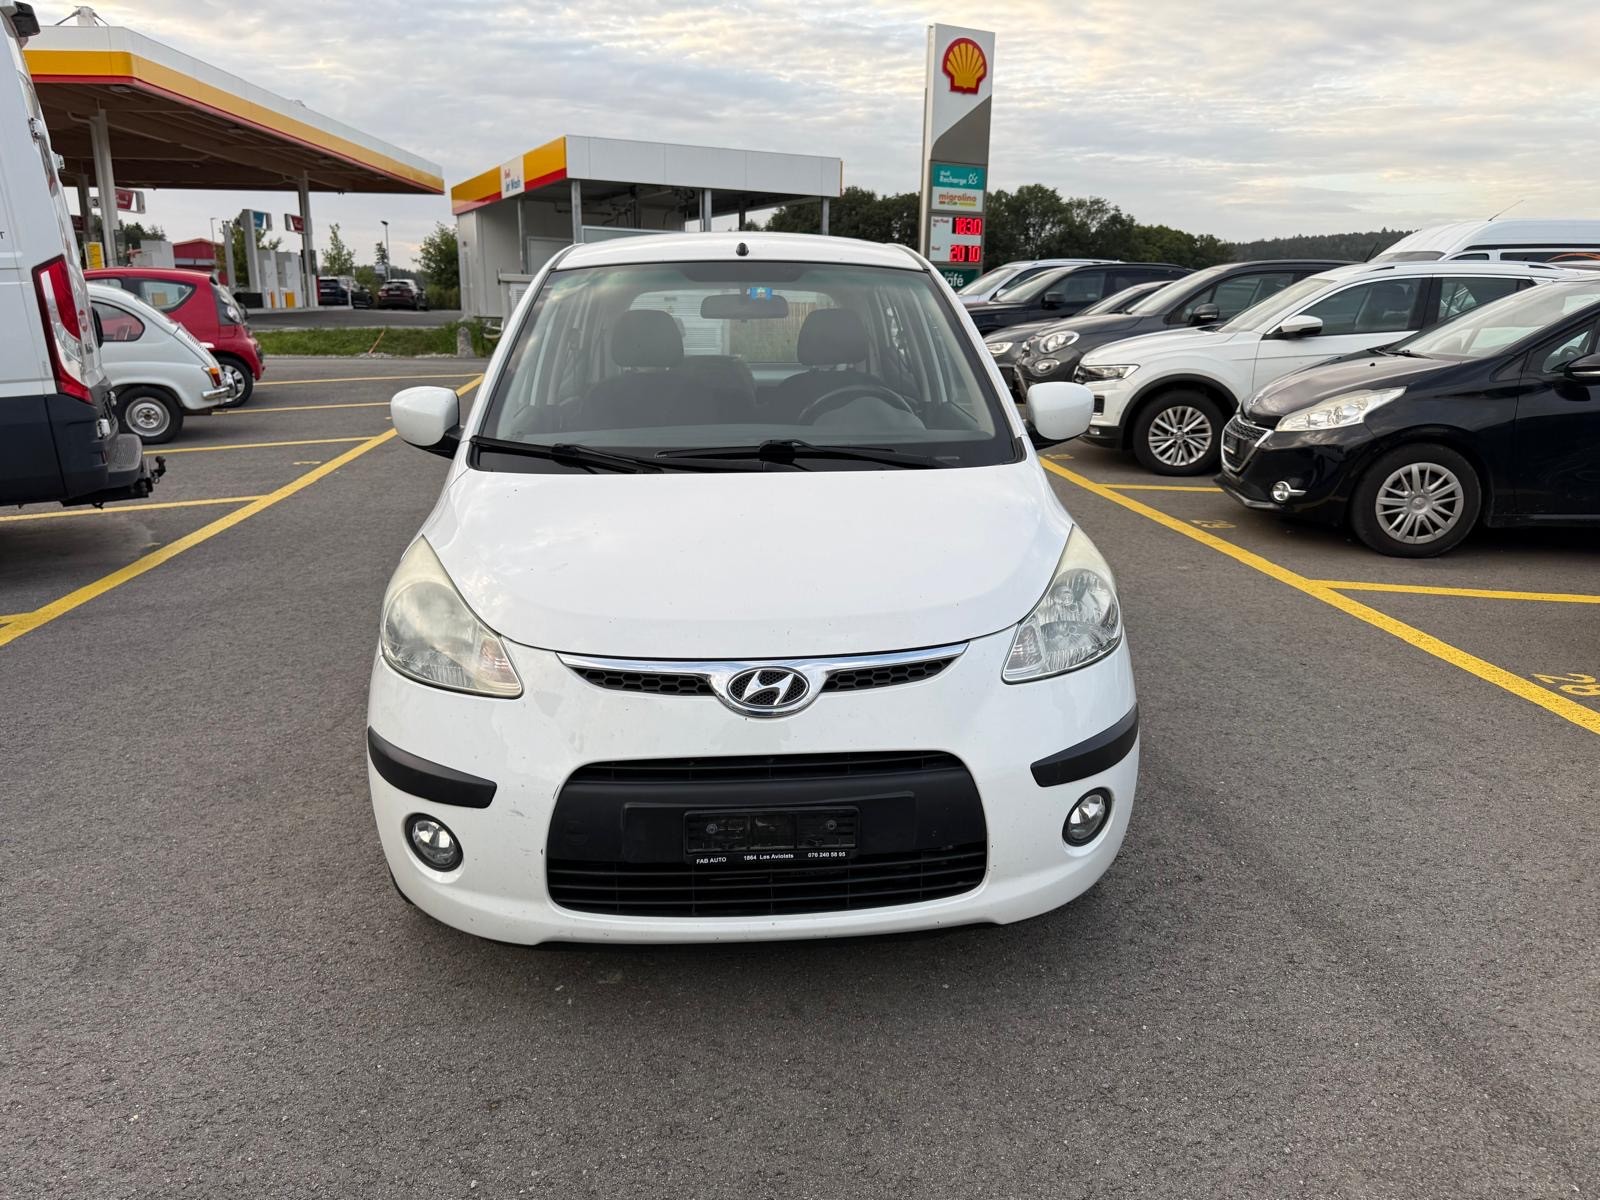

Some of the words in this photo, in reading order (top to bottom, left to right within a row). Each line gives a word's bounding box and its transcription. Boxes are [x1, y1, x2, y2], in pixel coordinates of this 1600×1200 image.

[938, 191, 977, 202] migrolino
[92, 198, 99, 207] 3
[945, 271, 964, 287] afé
[709, 856, 727, 864] AUTO
